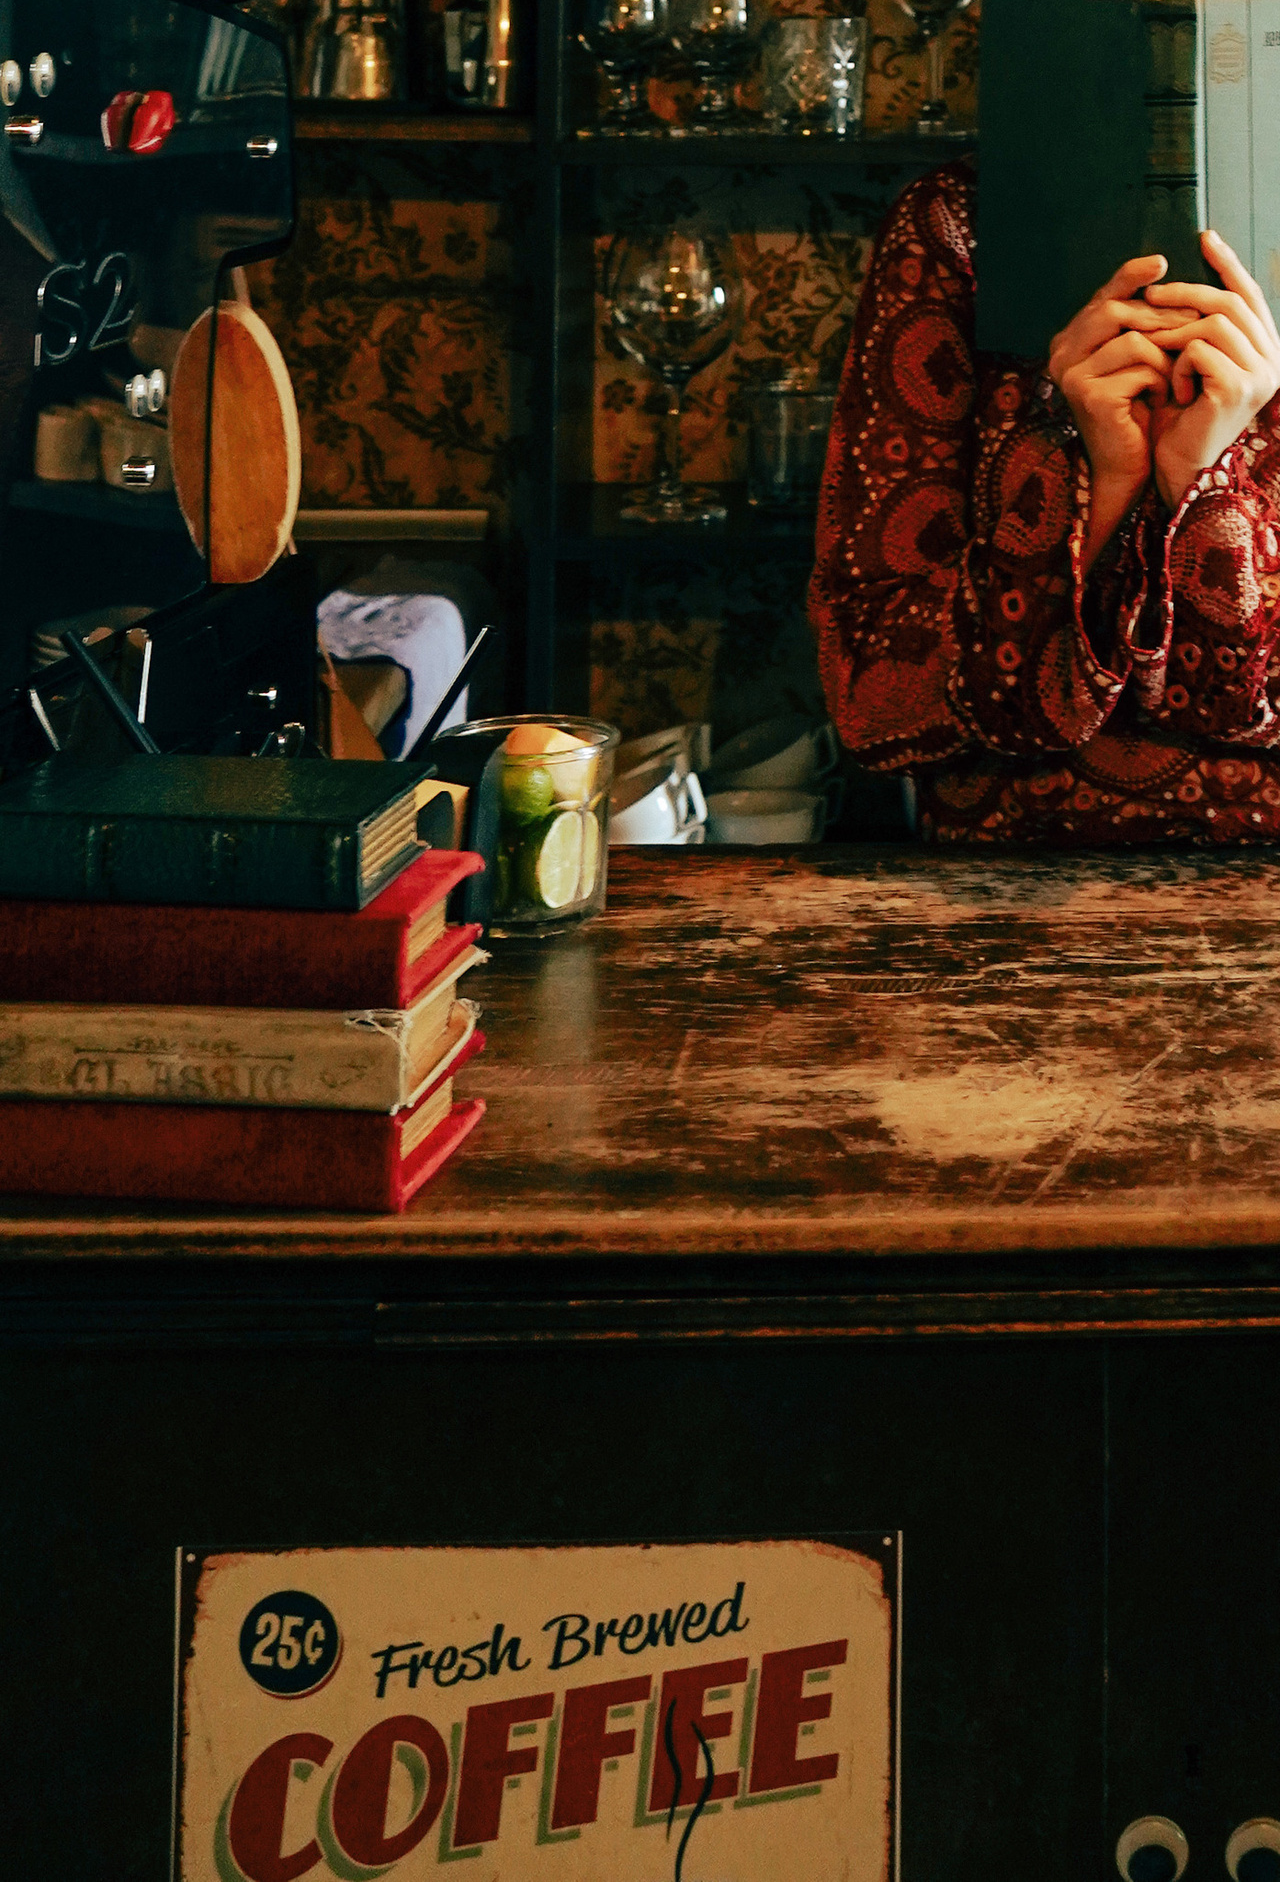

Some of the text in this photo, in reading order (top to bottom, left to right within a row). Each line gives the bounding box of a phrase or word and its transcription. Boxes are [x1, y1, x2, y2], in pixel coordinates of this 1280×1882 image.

[250, 1611, 326, 1670] 25¢
[371, 1581, 750, 1699] Fresh Brewed
[214, 1637, 850, 1882] COFFEE
